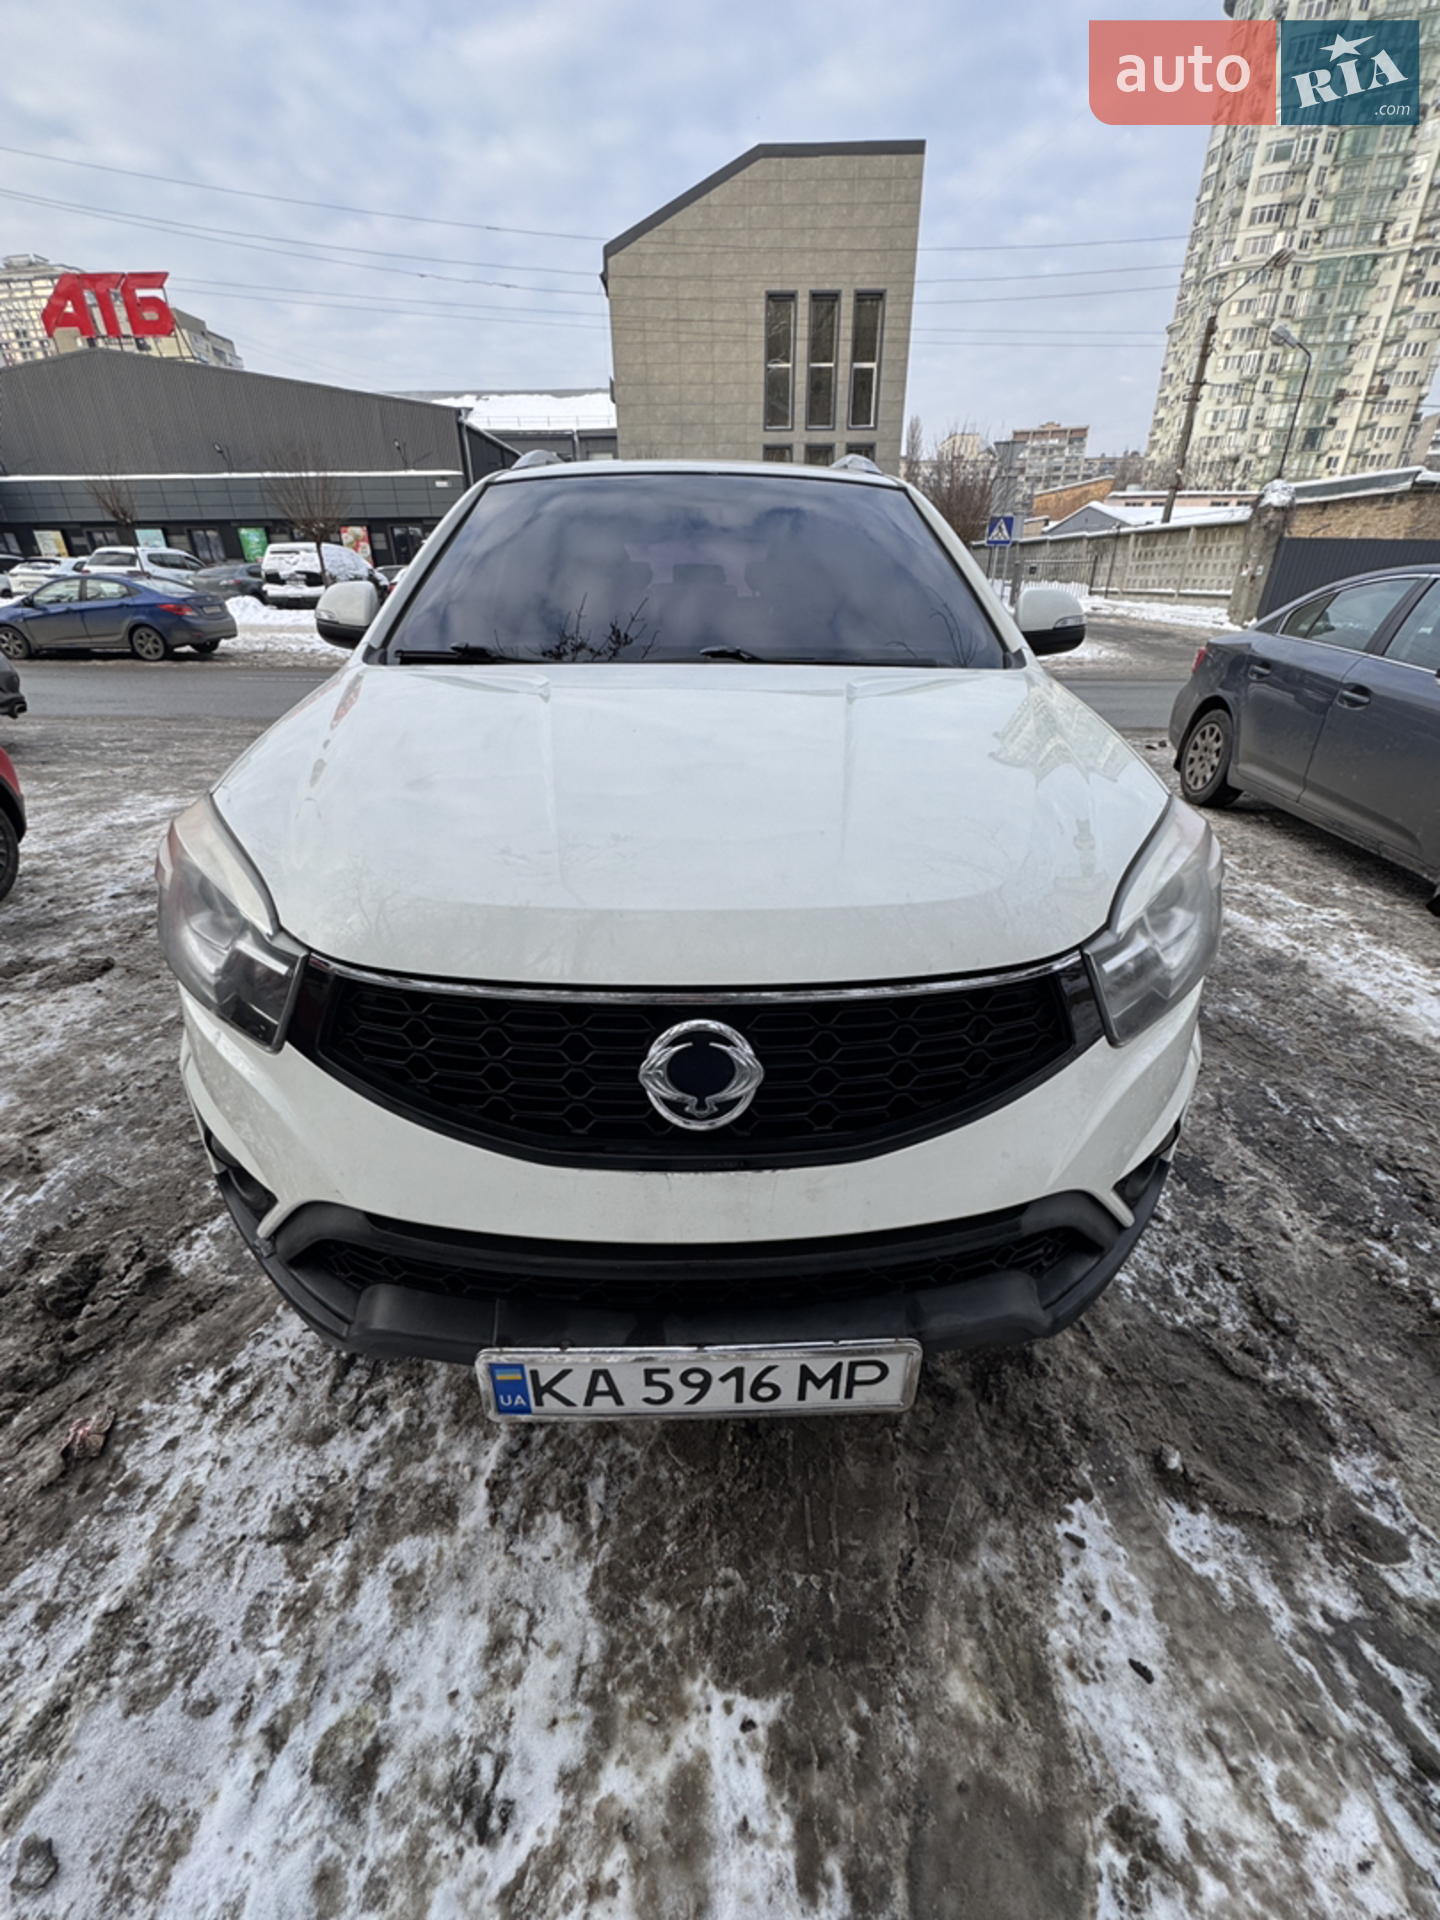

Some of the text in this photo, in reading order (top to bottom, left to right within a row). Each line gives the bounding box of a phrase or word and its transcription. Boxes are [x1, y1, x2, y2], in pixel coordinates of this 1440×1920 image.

[41, 271, 175, 338] АТБ
[500, 1394, 527, 1406] UA
[529, 1359, 890, 1407] KA 5916 MP
